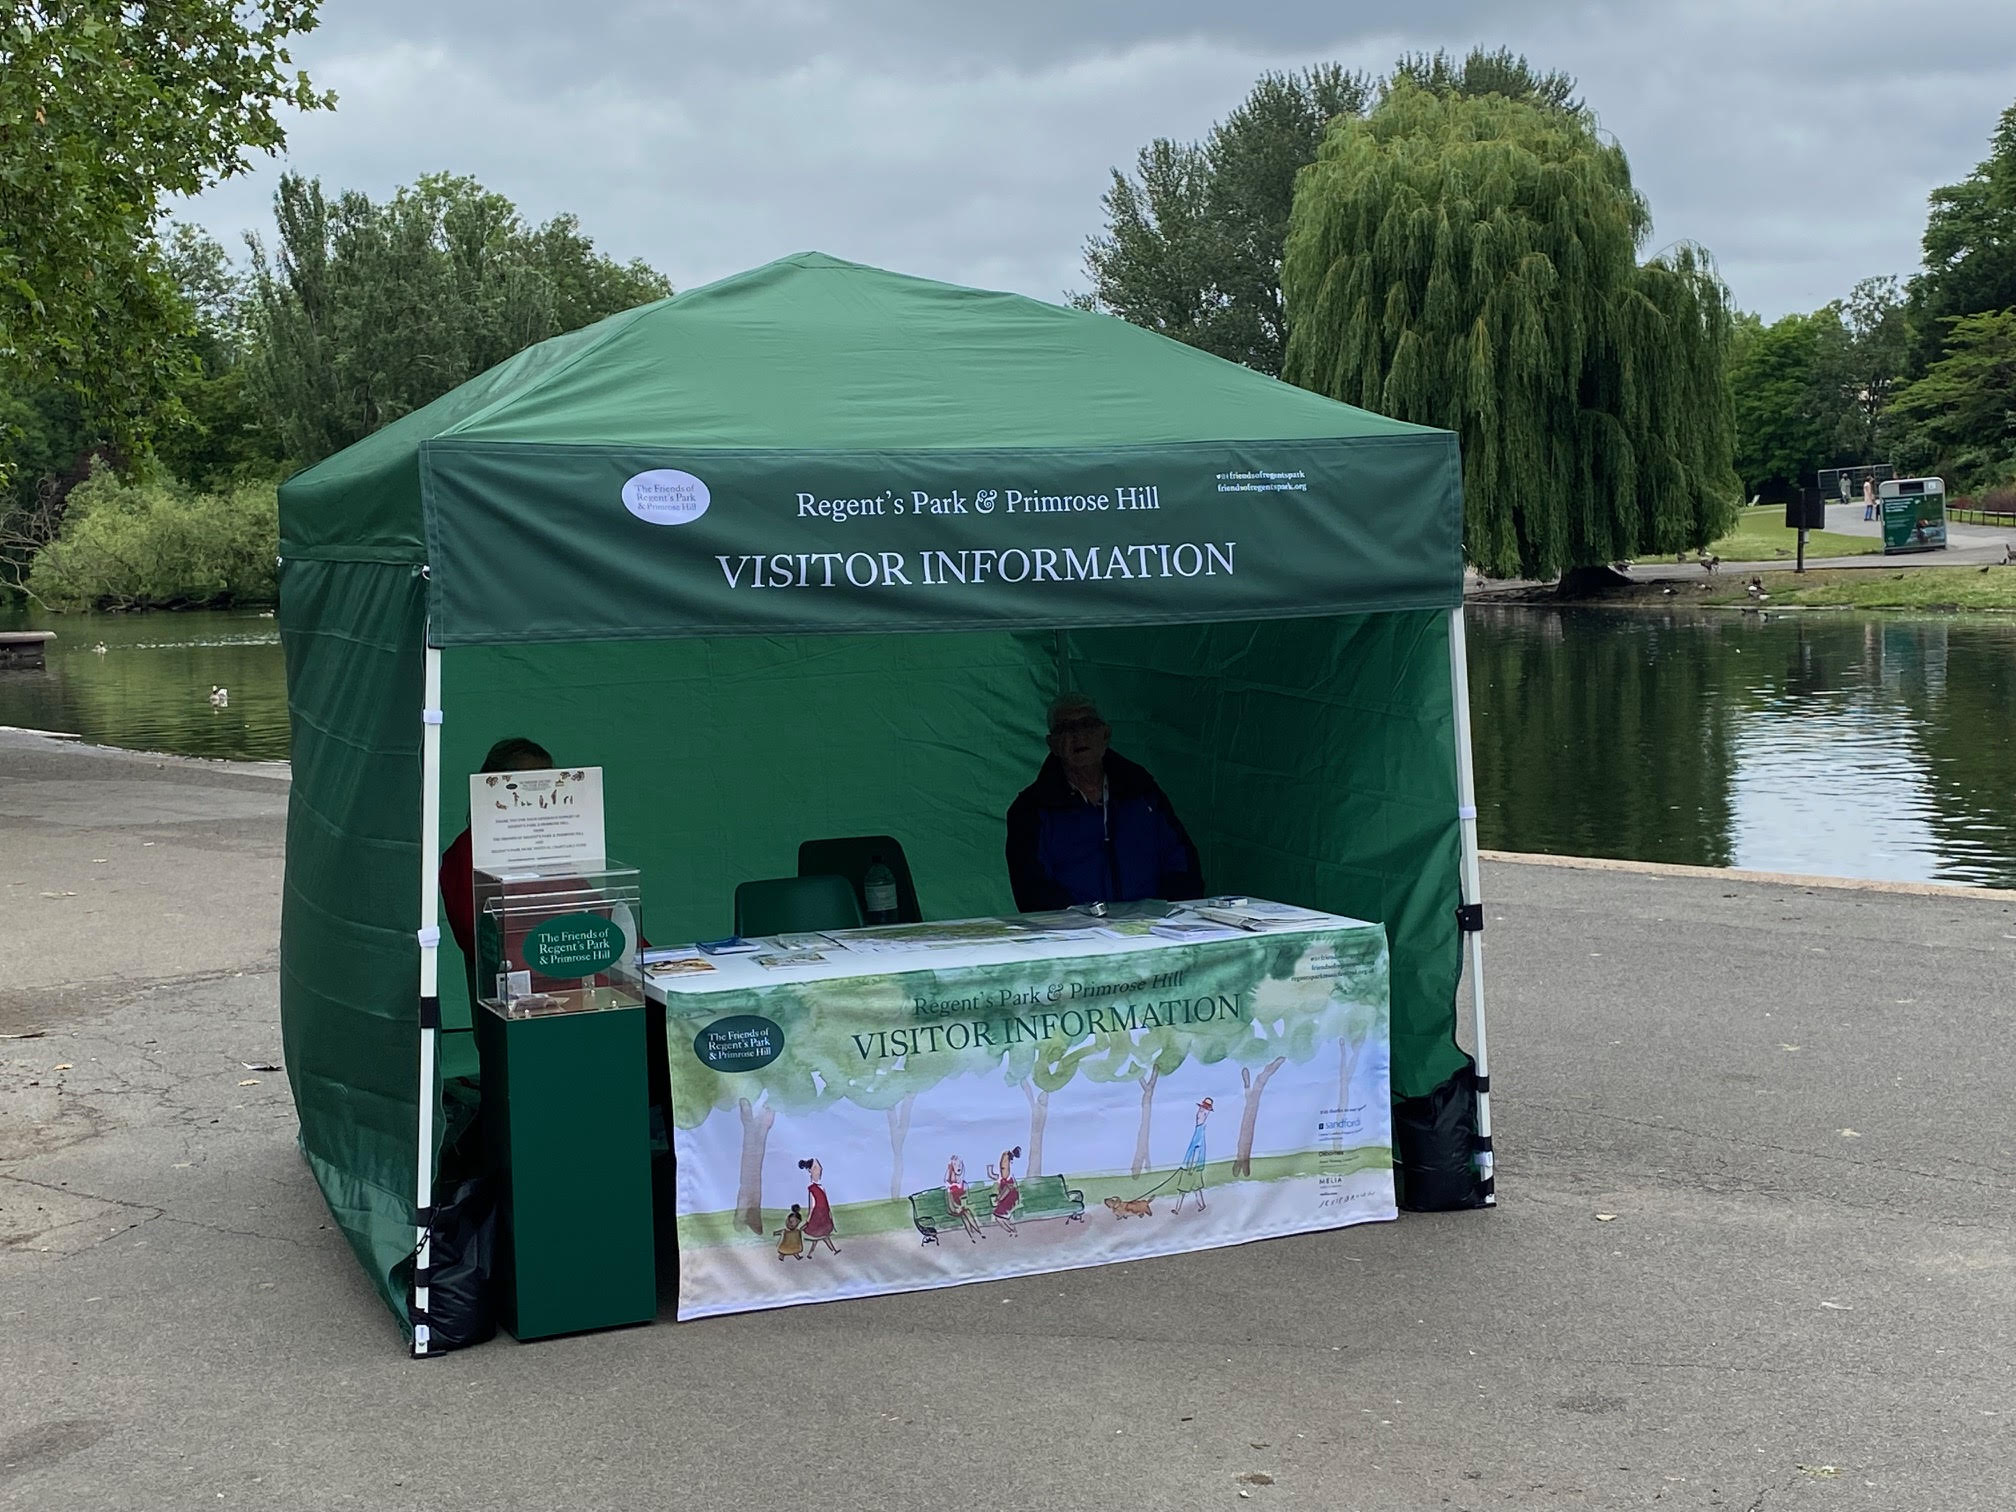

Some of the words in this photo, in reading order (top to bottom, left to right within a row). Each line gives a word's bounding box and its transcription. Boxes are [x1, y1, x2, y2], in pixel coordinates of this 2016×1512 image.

[634, 484, 652, 493] The
[654, 484, 685, 493] Friends
[912, 491, 967, 514] Park
[974, 489, 998, 513] &
[1005, 489, 1110, 512] Primrose
[1116, 487, 1160, 510] Hill
[715, 552, 912, 590] VISITOR
[920, 542, 1237, 585] INFORMATION
[539, 933, 559, 943] The
[561, 930, 598, 942] Friends
[599, 928, 608, 937] of
[587, 938, 610, 949] Park
[540, 956, 548, 965] &
[550, 954, 590, 964] Primrose
[594, 950, 610, 960] Hill
[1000, 986, 1040, 1006] Park
[1046, 984, 1064, 1002] &
[1071, 979, 1147, 1000] Primrose
[1153, 970, 1183, 989] Hill
[851, 1021, 995, 1060] VISITOR
[1004, 992, 1240, 1044] INFORMATION
[728, 1029, 759, 1040] Friends
[760, 1028, 768, 1036] of
[750, 1037, 770, 1046] Park
[718, 1050, 754, 1059] Primrose
[756, 1047, 771, 1056] Hill
